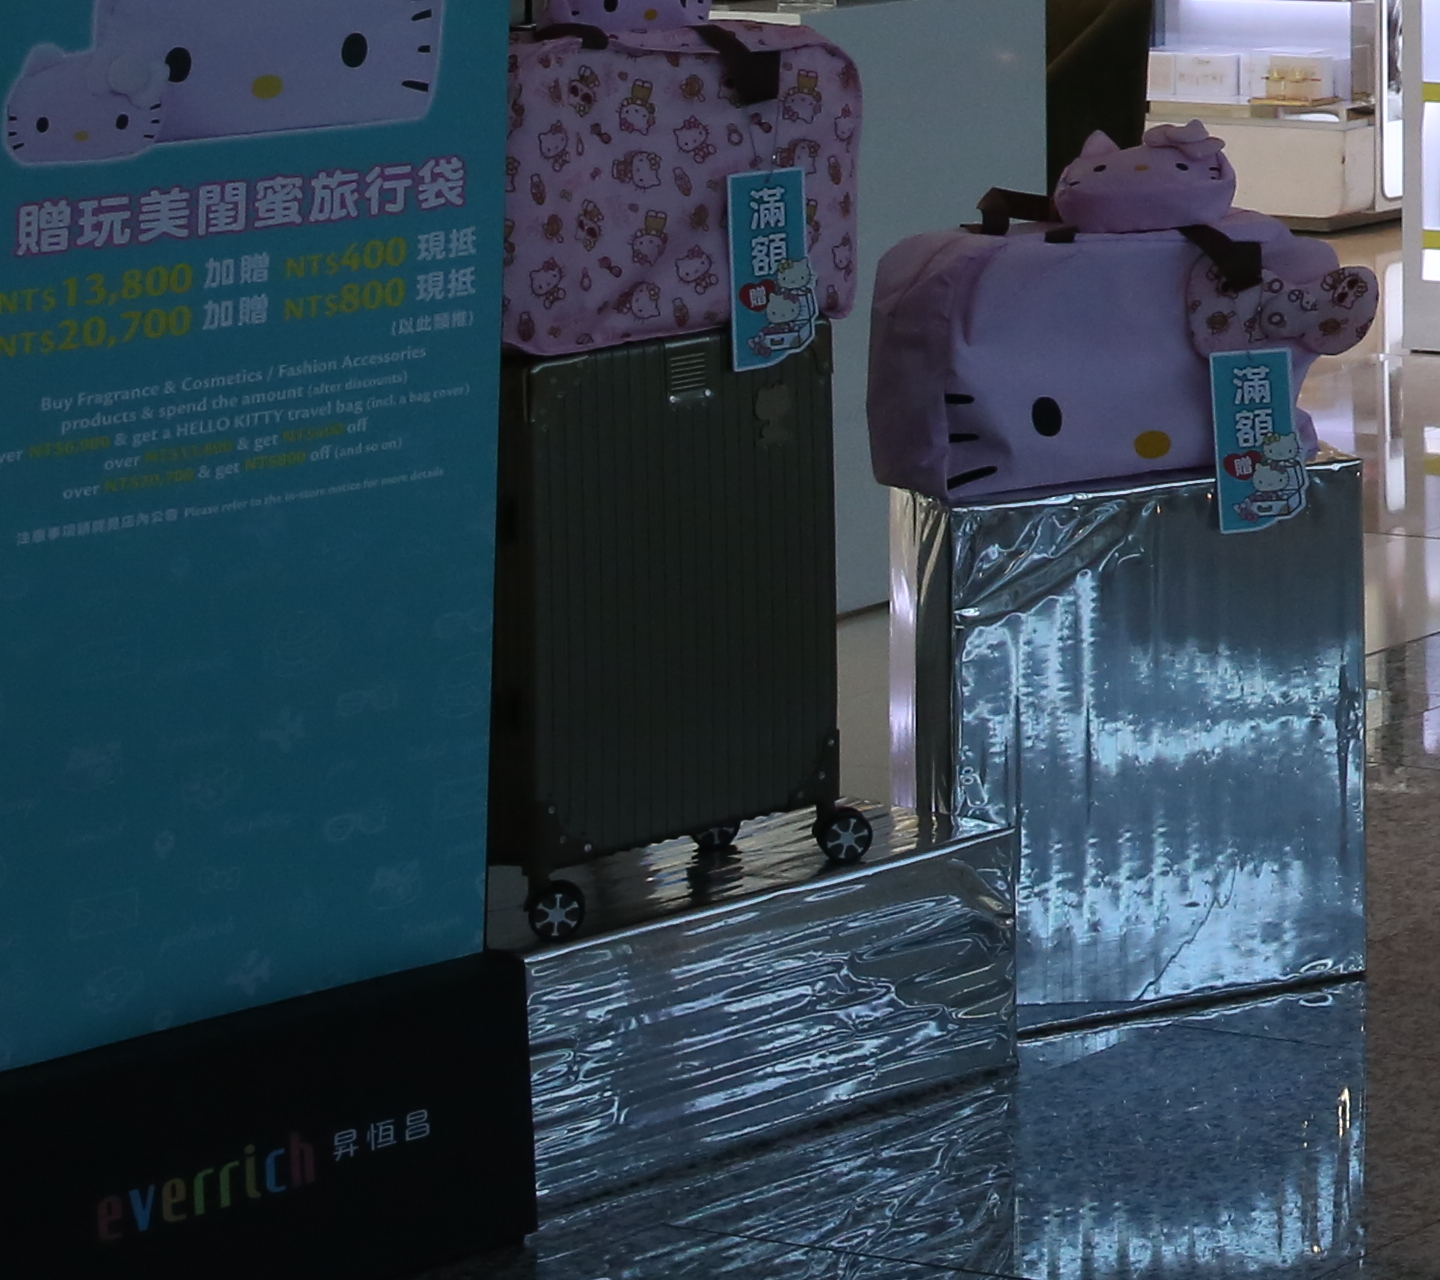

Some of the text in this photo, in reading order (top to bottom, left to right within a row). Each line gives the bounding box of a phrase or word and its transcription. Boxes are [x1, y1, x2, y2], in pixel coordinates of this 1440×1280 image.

[13, 155, 467, 256] 贈玩美閨蜜旅行袋
[750, 186, 788, 278] 滿額
[203, 252, 271, 290] 加贈
[285, 236, 408, 280] NT$400
[416, 226, 478, 263] 現抵
[202, 294, 270, 332] 加贈
[284, 277, 407, 323] NT$800
[415, 267, 477, 304] 現抵
[748, 285, 768, 310] 贈
[40, 396, 74, 412] Buy
[78, 382, 160, 407] Fragrance
[163, 380, 177, 395] &
[181, 368, 263, 392] Cosmetics
[278, 358, 338, 378] Fashion
[341, 346, 427, 369] Accessories
[61, 409, 137, 436] products
[140, 406, 154, 420] &
[158, 396, 208, 420] spend
[211, 393, 239, 410] the
[242, 385, 304, 405] amount
[308, 382, 342, 398] (after
[1232, 365, 1275, 449] 滿額
[1233, 453, 1253, 478] 贈
[96, 1129, 316, 1241] everrich
